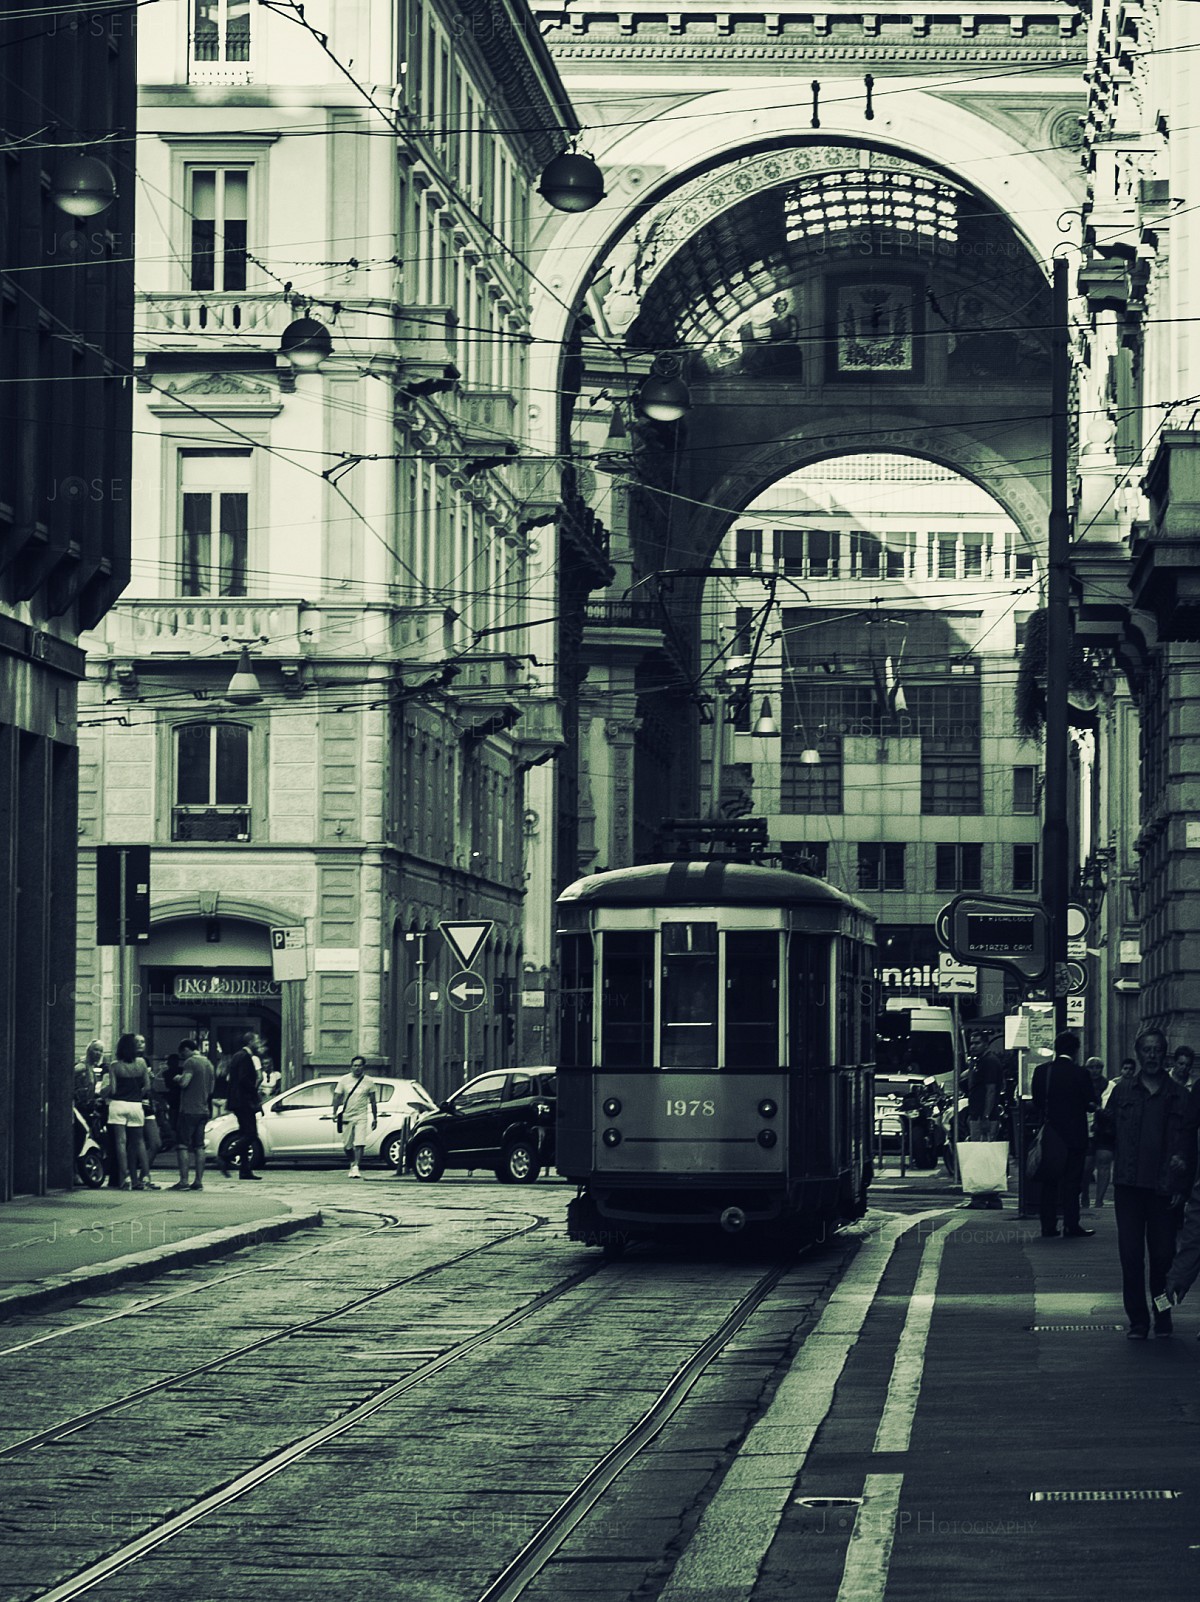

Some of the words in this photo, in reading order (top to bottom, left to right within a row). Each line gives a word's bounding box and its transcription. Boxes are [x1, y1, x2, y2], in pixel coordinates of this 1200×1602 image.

[274, 933, 284, 948] P
[177, 978, 207, 994] ING
[230, 979, 282, 995] DIREC
[666, 1099, 716, 1117] 1978
